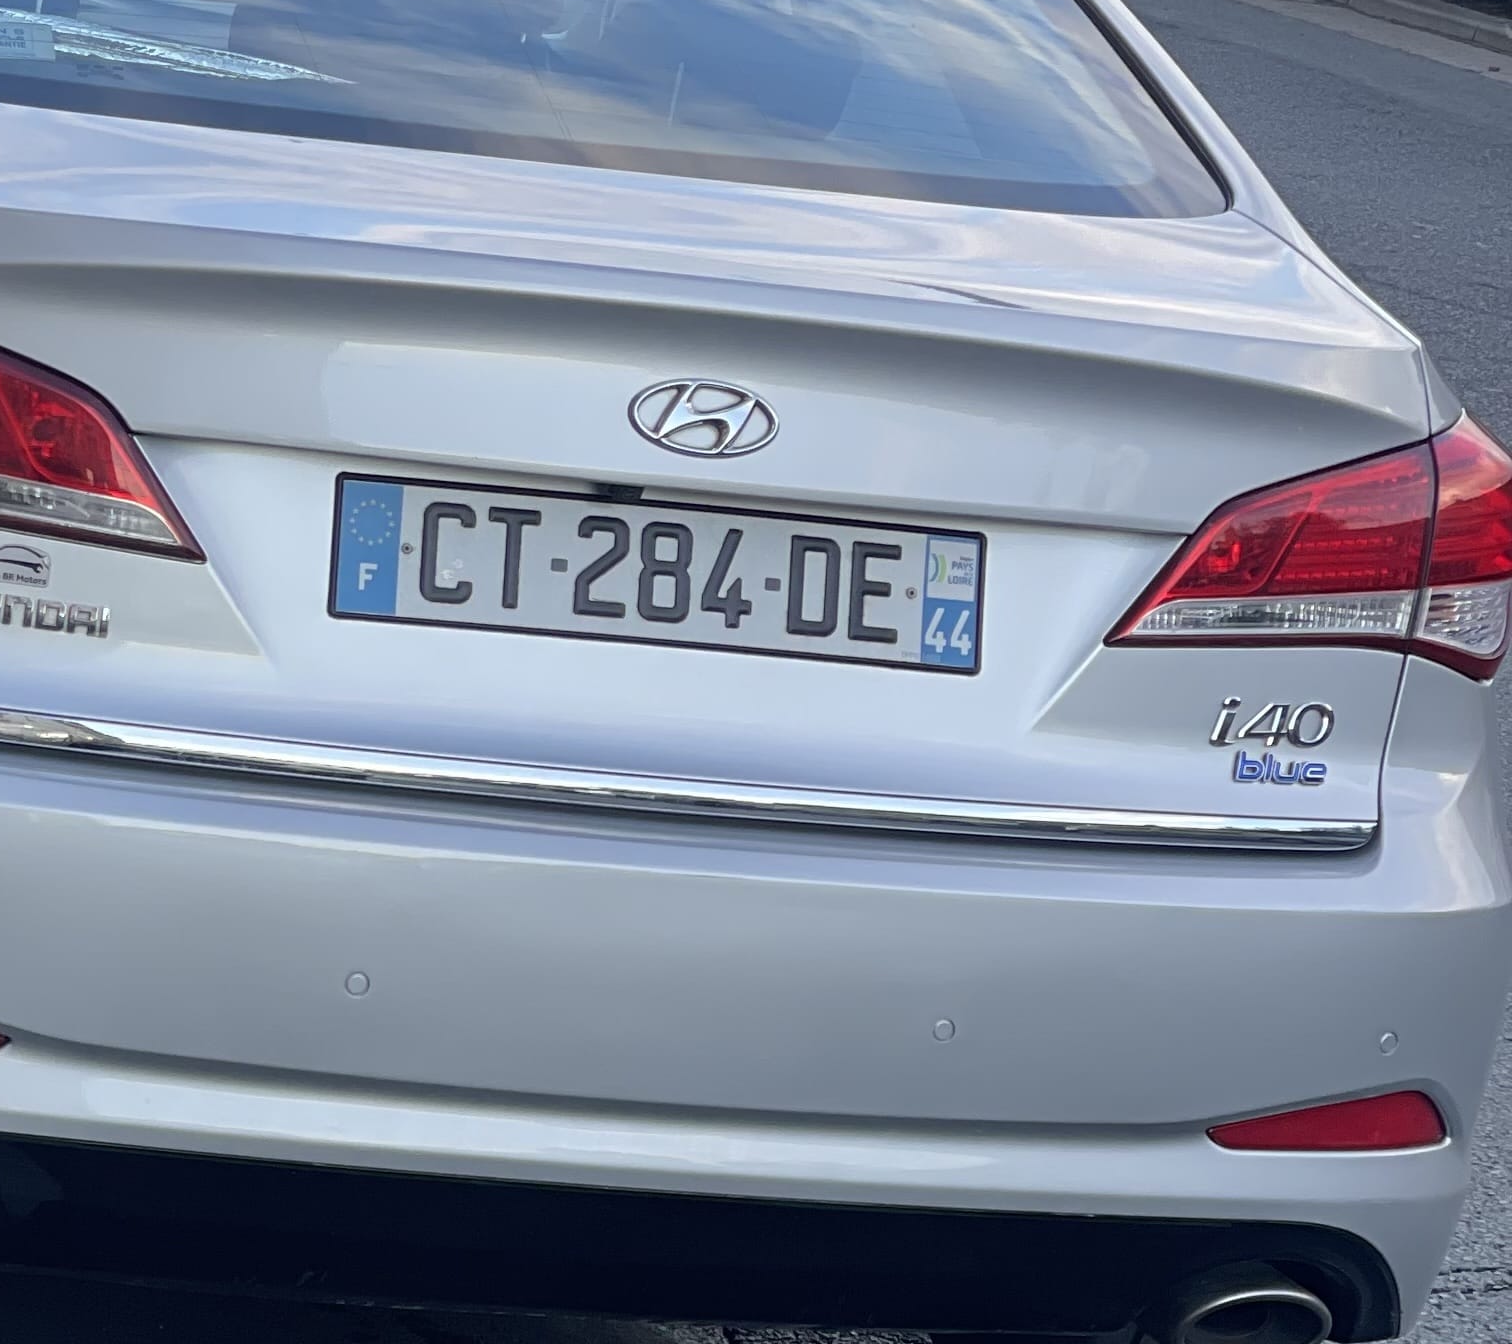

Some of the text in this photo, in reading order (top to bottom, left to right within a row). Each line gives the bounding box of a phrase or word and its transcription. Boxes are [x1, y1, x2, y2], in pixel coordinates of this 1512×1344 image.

[357, 562, 379, 591] F
[418, 501, 902, 645] CT-284-DE
[947, 575, 974, 587] LOIRE
[951, 561, 975, 571] PAYS
[924, 607, 972, 656] 44
[1209, 696, 1336, 748] i40
[1232, 751, 1328, 785] blue
